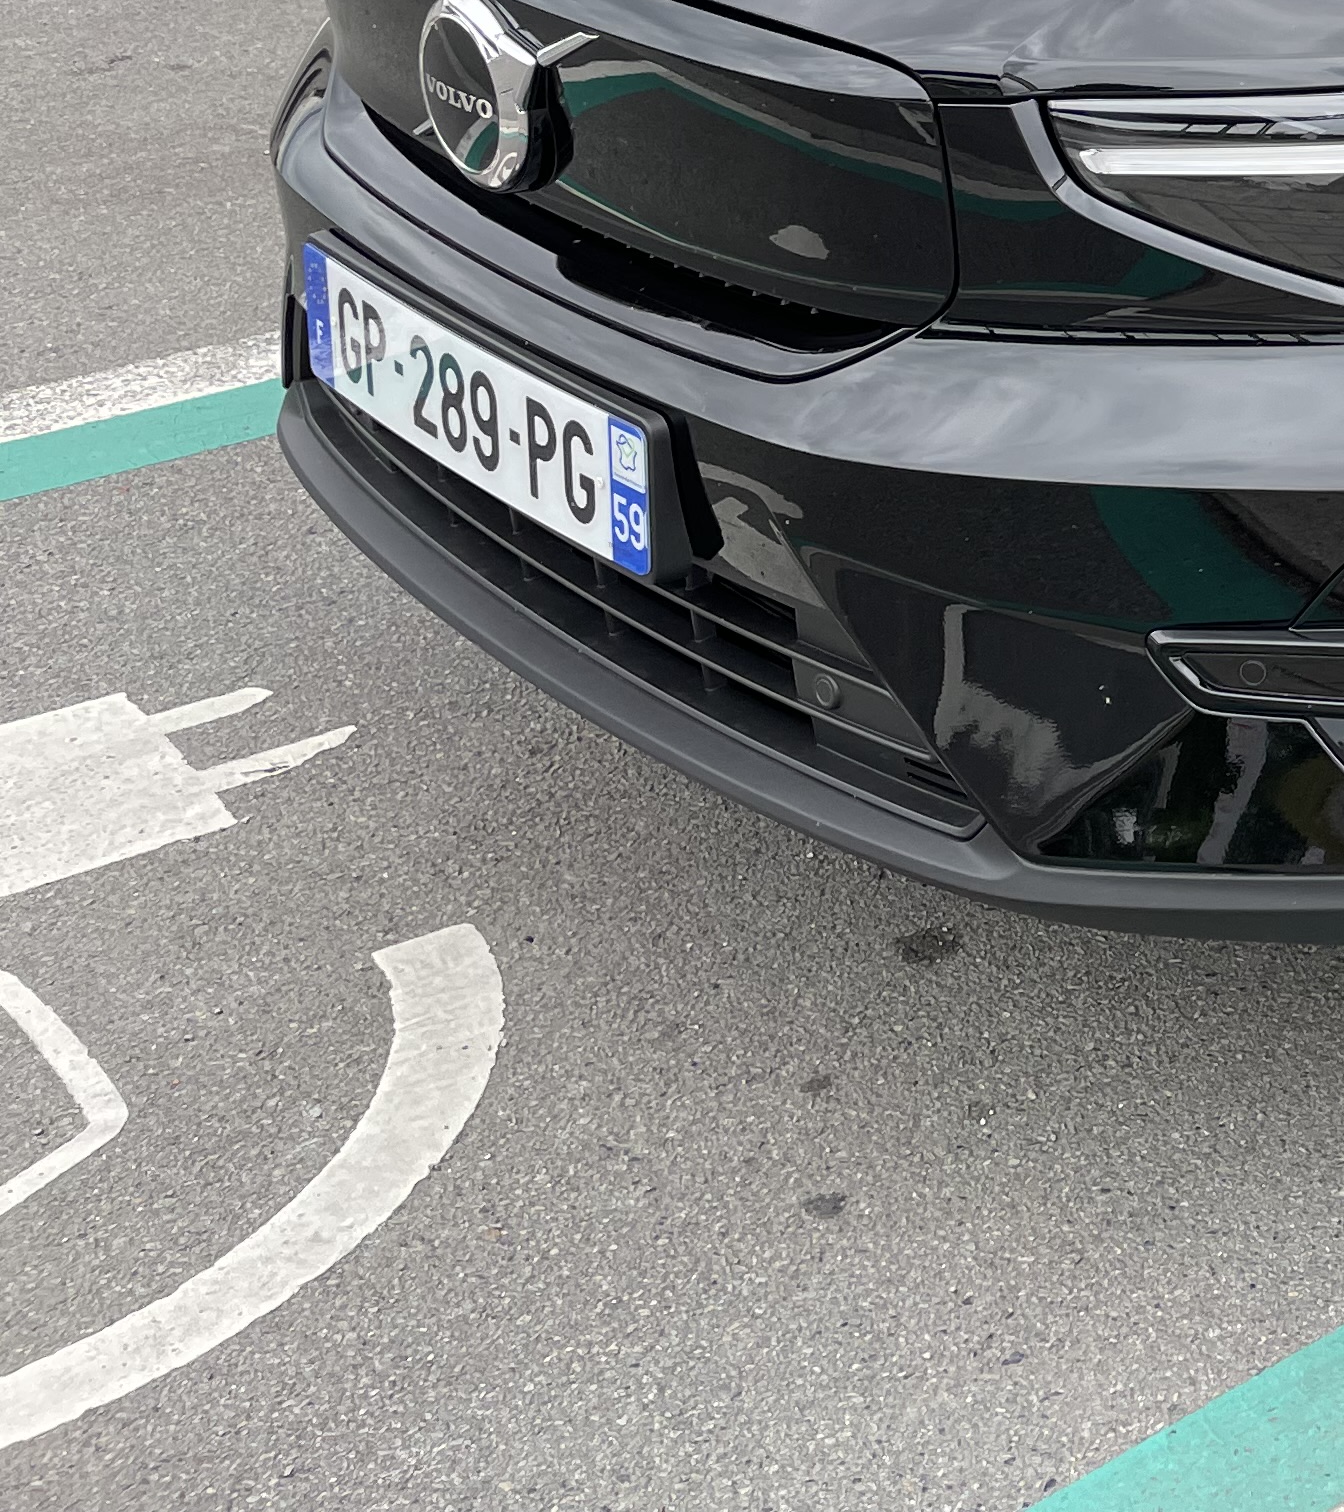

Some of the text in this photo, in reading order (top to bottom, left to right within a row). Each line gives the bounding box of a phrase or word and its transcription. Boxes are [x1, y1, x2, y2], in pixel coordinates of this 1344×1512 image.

[425, 72, 493, 119] VOLVO
[338, 287, 597, 525] GP-289-PG
[613, 492, 645, 551] 59
